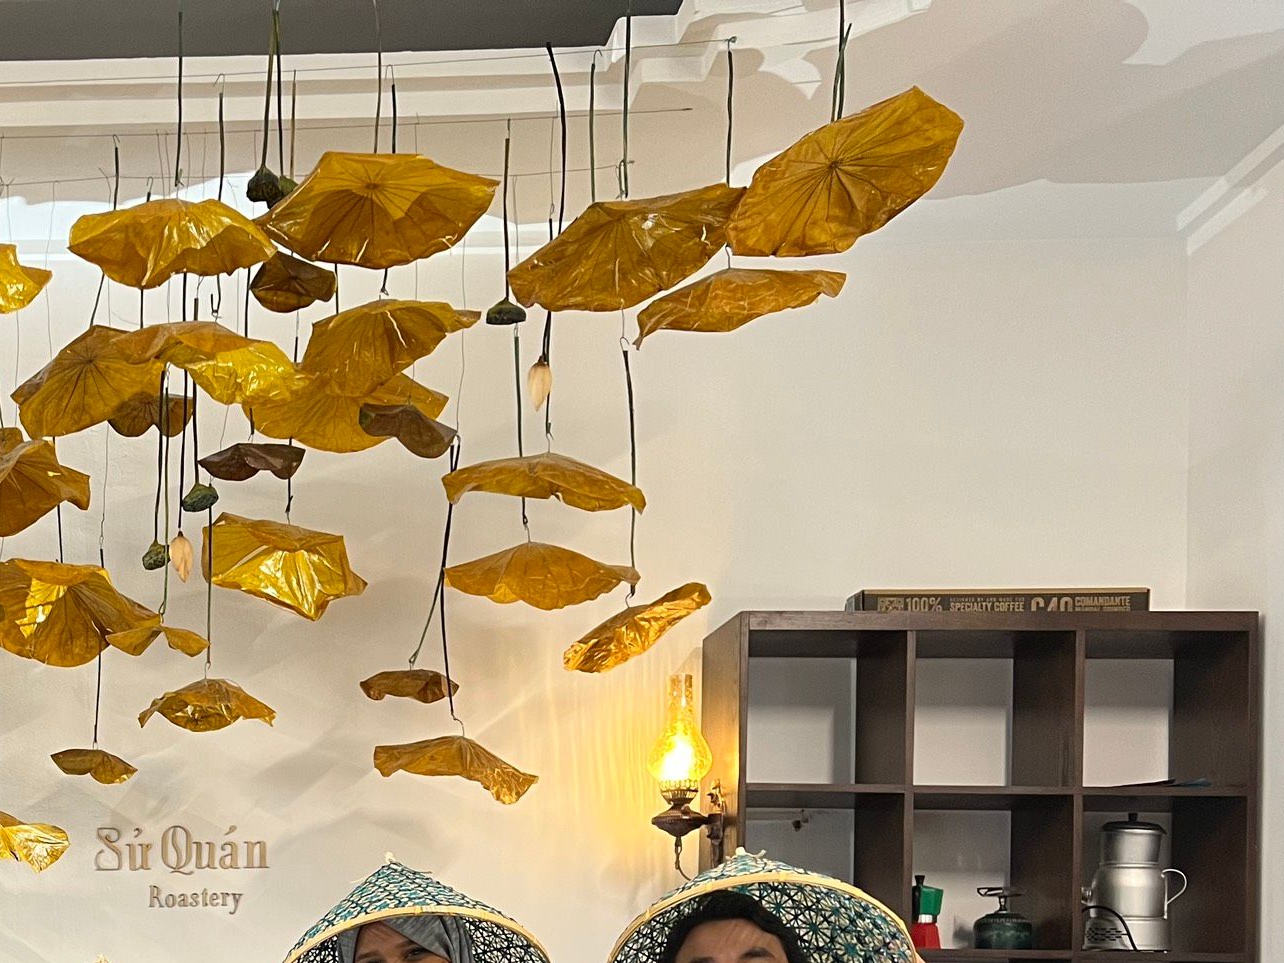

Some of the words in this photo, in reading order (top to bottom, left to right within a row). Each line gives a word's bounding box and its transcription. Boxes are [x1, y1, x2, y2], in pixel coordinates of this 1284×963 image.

[906, 596, 942, 612] 100%
[949, 602, 992, 612] SPECIALTY
[994, 602, 1025, 612] COFFEE
[161, 825, 270, 875] Quán
[148, 885, 243, 915] Roastery
